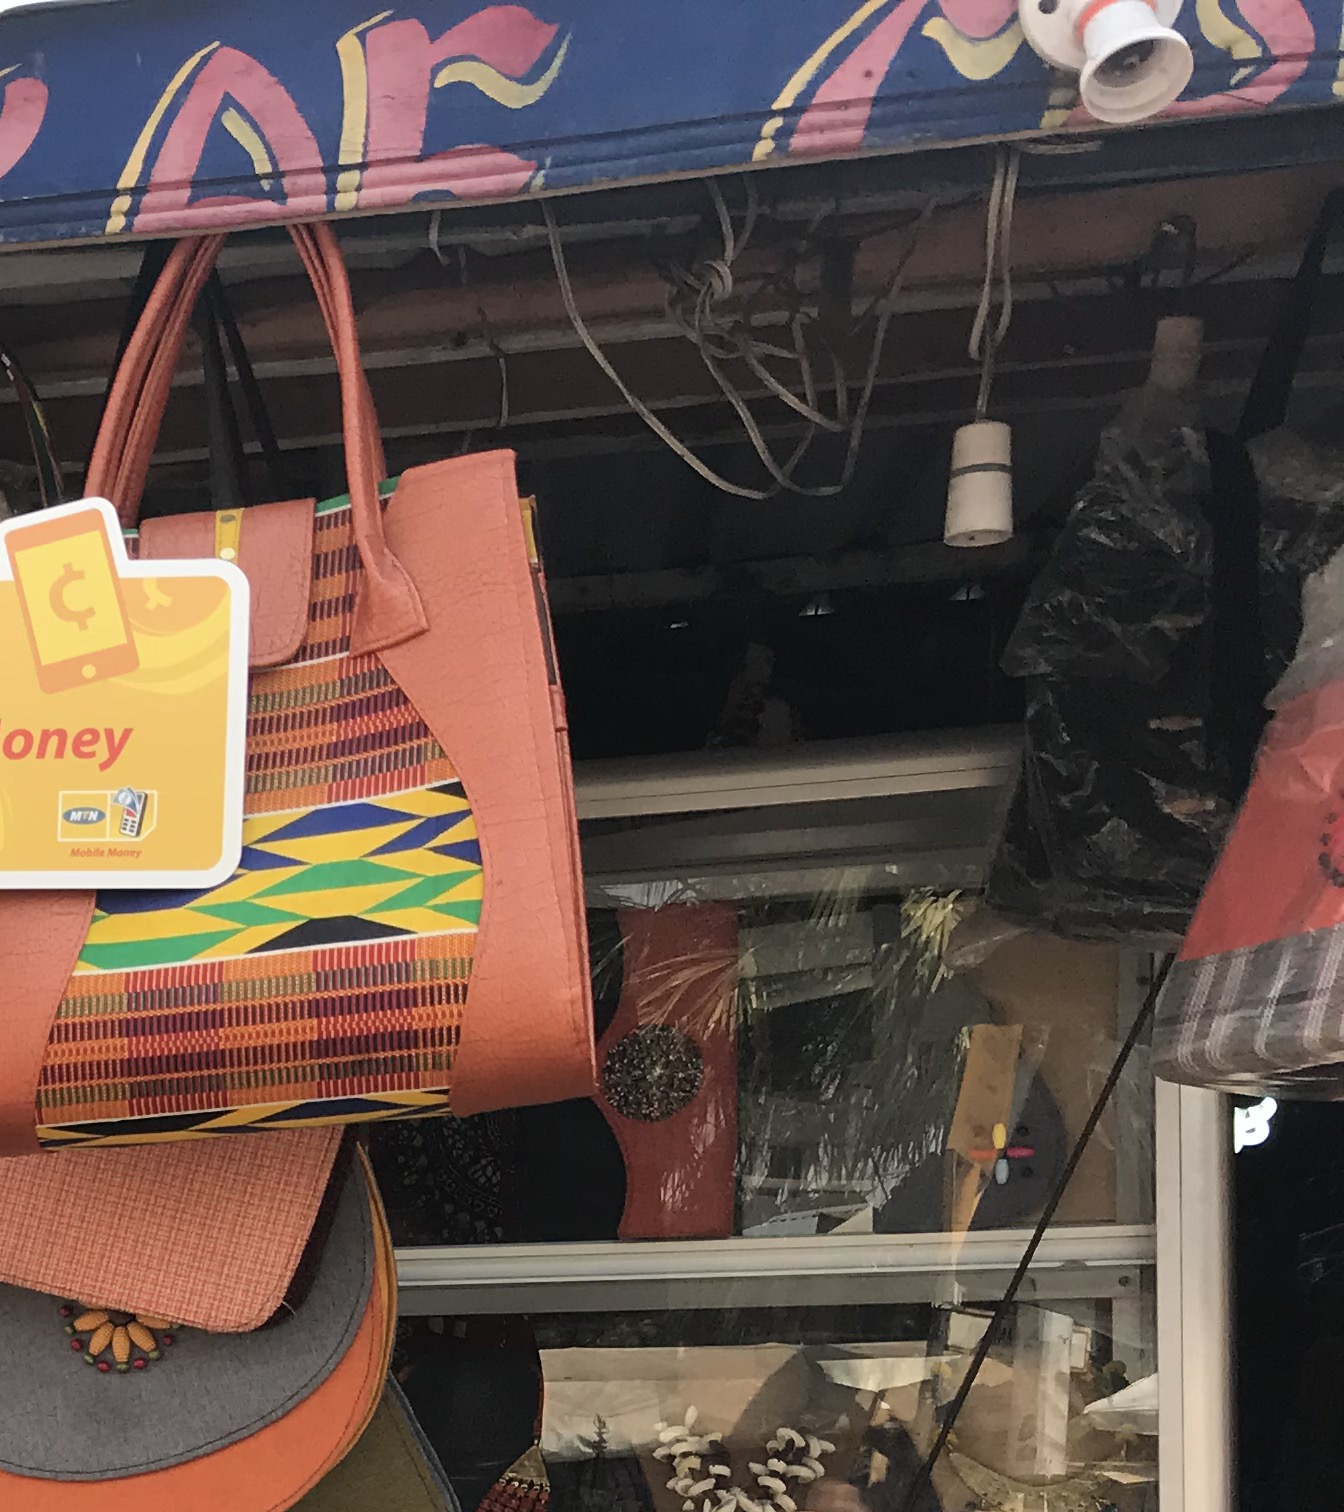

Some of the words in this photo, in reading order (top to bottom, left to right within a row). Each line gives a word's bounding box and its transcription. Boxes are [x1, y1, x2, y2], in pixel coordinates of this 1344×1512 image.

[69, 810, 99, 822] MTN
[69, 847, 105, 858] Mobile
[106, 847, 143, 860] Money
